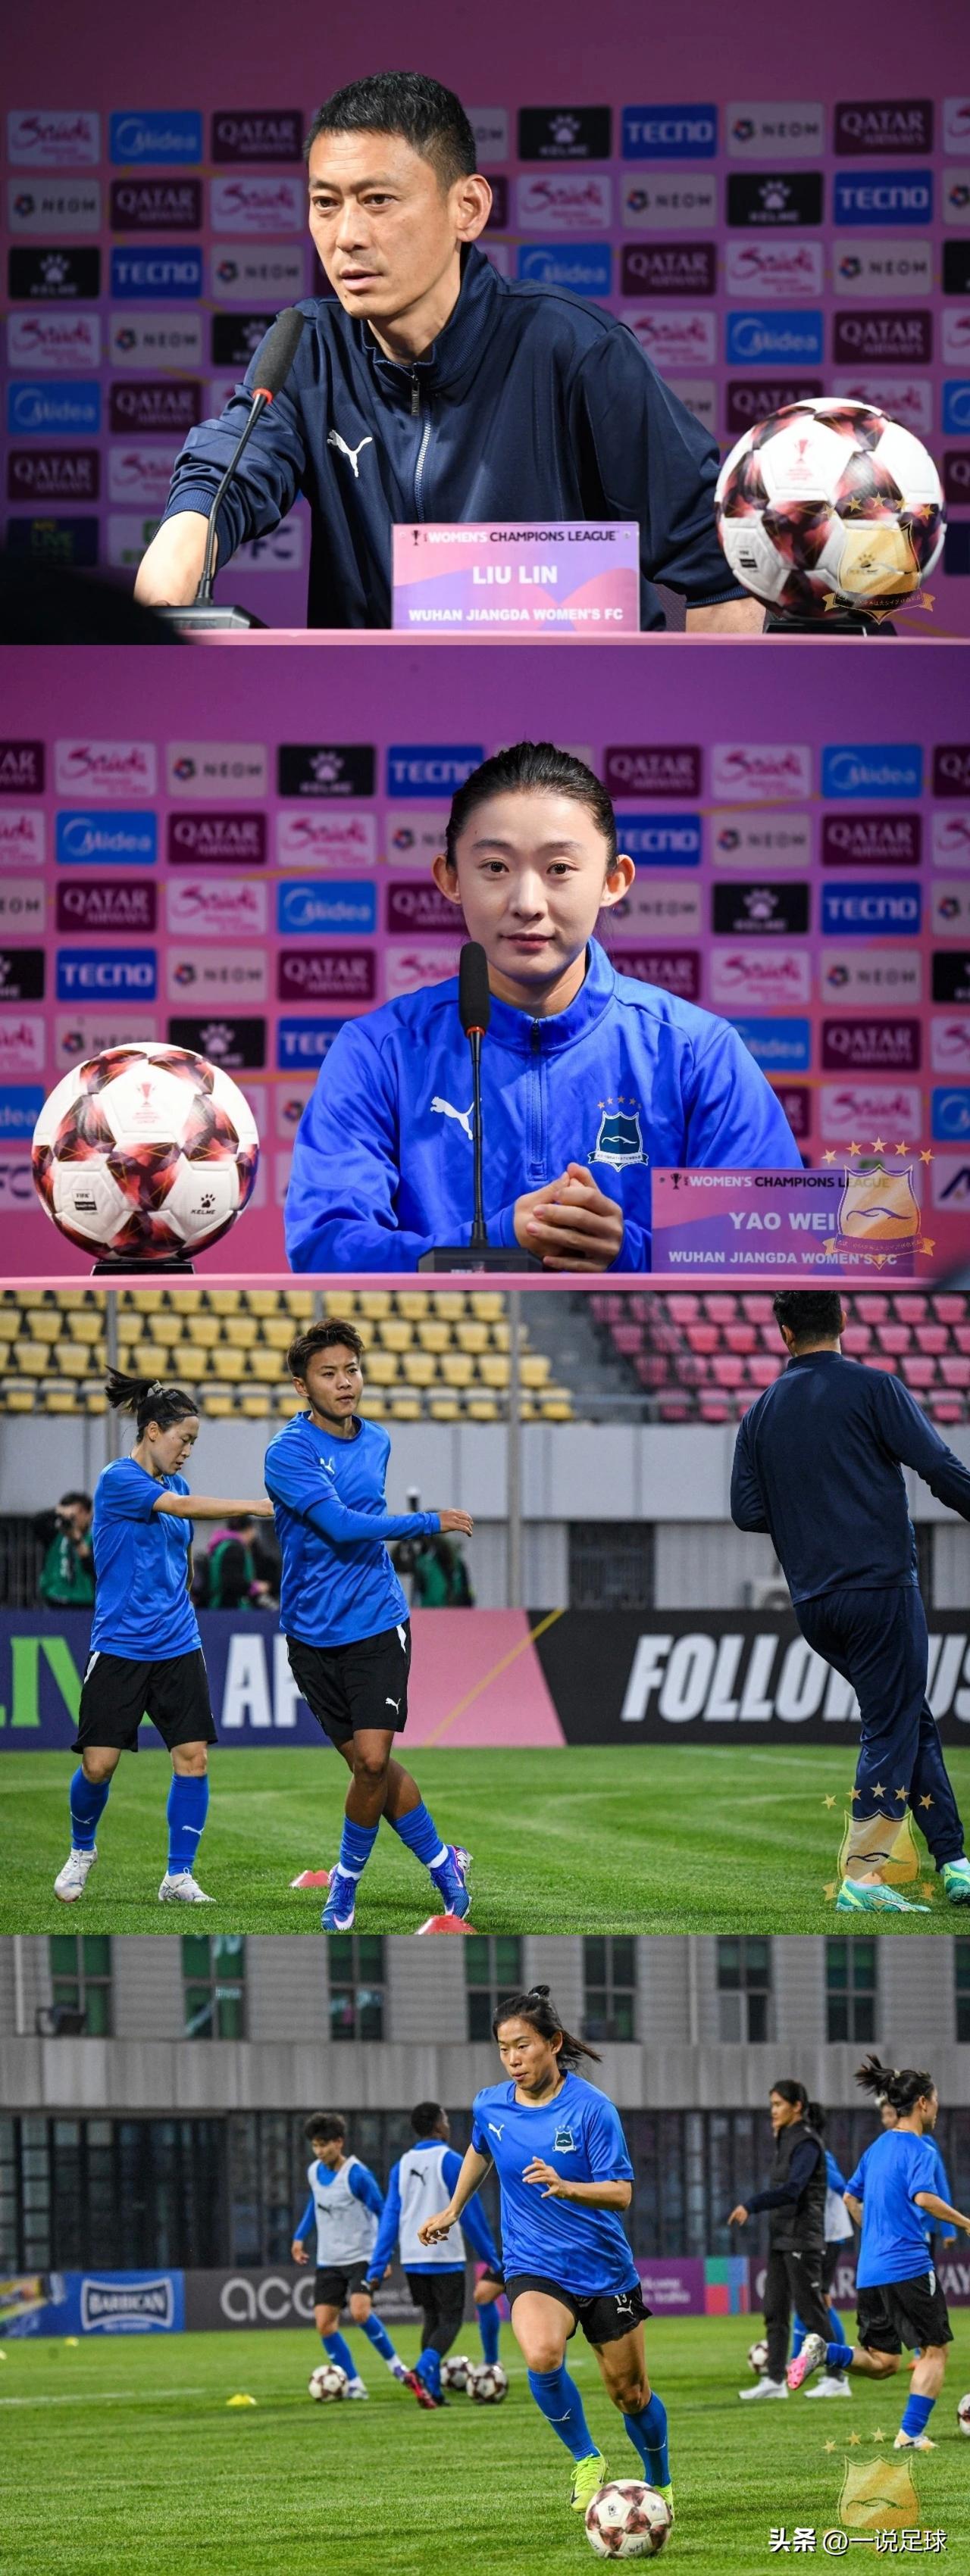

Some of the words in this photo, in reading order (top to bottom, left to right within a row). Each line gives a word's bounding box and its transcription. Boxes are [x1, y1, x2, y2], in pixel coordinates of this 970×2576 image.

[218, 121, 296, 143] QATAR
[628, 121, 711, 143] TECNO
[840, 111, 924, 137] QATAR
[117, 188, 194, 213] QATAR
[837, 187, 929, 209] TECNO
[117, 261, 198, 284] TECNO
[627, 253, 707, 276] QATAR
[839, 320, 923, 346] QATAR
[116, 392, 193, 414] QATAR
[15, 458, 90, 482] QATAR
[428, 532, 487, 543] WOMEN'S
[490, 531, 564, 542] CHAMPIONS
[568, 530, 616, 542] LEAGUE
[472, 566, 512, 584] LIU
[519, 565, 557, 584] LIN
[408, 609, 462, 621] WUHAN
[466, 608, 530, 620] JIANGDA
[533, 607, 601, 620] WOMEN'S
[605, 607, 623, 620] FC
[608, 754, 693, 777] QATAR
[174, 820, 258, 847] QATAR
[828, 823, 912, 848] QATAR
[64, 888, 148, 914] QATAR
[828, 898, 916, 921] TECNO
[61, 963, 153, 987] TECNO
[283, 958, 368, 983] QATAR
[827, 1027, 912, 1051] QATAR
[689, 1176, 753, 1188] WOMEN'S
[755, 1176, 834, 1188] CHAMPIONS
[729, 1212, 781, 1230] YAO
[788, 1213, 834, 1231] WEI
[668, 1251, 725, 1264] WUHAN
[730, 1252, 797, 1264] JIANGDA
[801, 1253, 871, 1265] WOMEN'S
